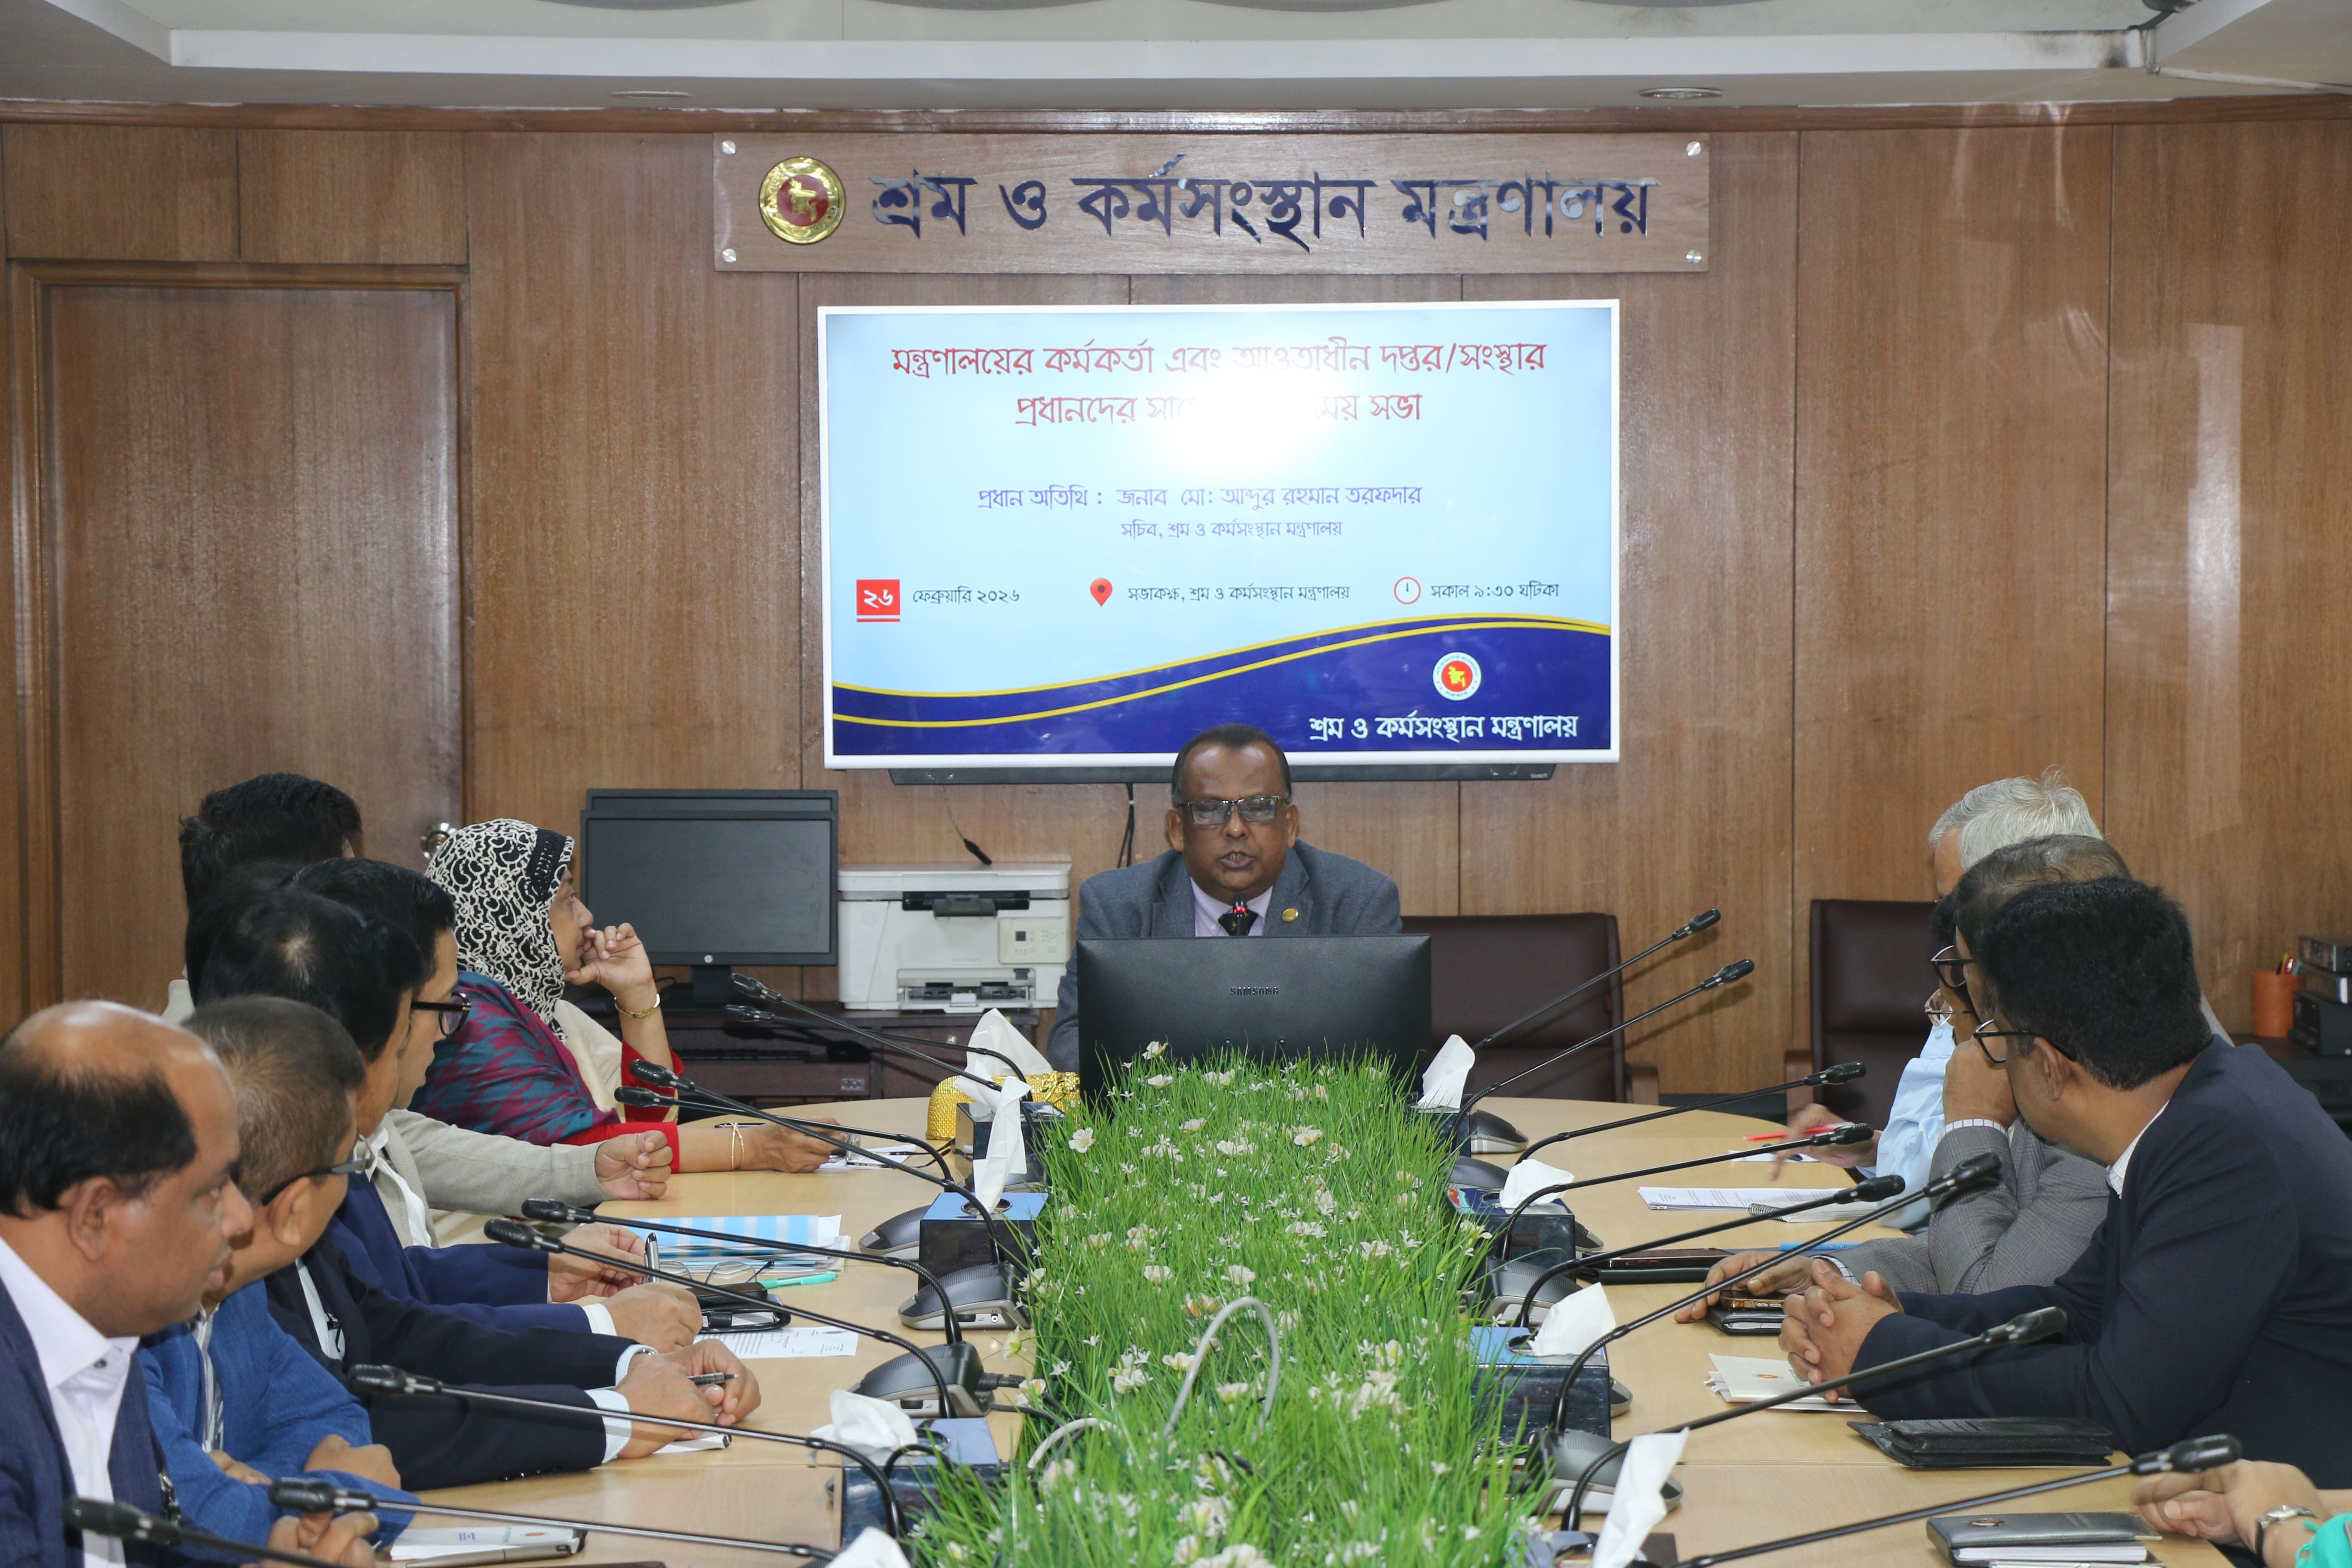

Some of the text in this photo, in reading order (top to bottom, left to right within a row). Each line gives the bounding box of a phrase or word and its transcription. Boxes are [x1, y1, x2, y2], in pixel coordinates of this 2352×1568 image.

[869, 168, 978, 239] শ্রম
[998, 180, 1047, 230] ও
[1070, 153, 1378, 254] কর্মসংস্থান
[1390, 170, 1661, 241] মন্ত্রণালয়
[891, 348, 1035, 378] মন্ত্রণালয়ের
[1043, 338, 1155, 373] কর্মকর্তা
[1165, 347, 1223, 374] এবং
[1231, 336, 1371, 372] আওতাধীন
[1015, 396, 1138, 426] প্রধানদের
[1368, 394, 1422, 420] সভা
[978, 489, 1023, 509] প্রধান
[1029, 484, 1088, 510] অতিথি
[1116, 488, 1168, 508] জনাব
[1219, 488, 1276, 511] আব্দুর
[1280, 487, 1340, 506] রহমান
[1345, 487, 1422, 505] তরফদার
[1121, 518, 1343, 540] সচিব, শ্রম ও কর্মসংস্থান মন্ত্রণালয়
[863, 585, 1020, 609] ২৬ ফেব্রুয়ারি ২০২৬
[1189, 587, 1209, 601] শ্রম
[1215, 587, 1224, 600] ও
[1228, 583, 1293, 602] কর্মসংস্থান
[1298, 586, 1350, 601] মন্ত্রণালয়
[1430, 580, 1559, 600] সকাল ৯:৩০ ঘটিকা
[1309, 710, 1579, 743] শ্রম ও কর্মসংস্থান মন্ত্রণালয়
[1231, 986, 1279, 995] SAMSUNG
